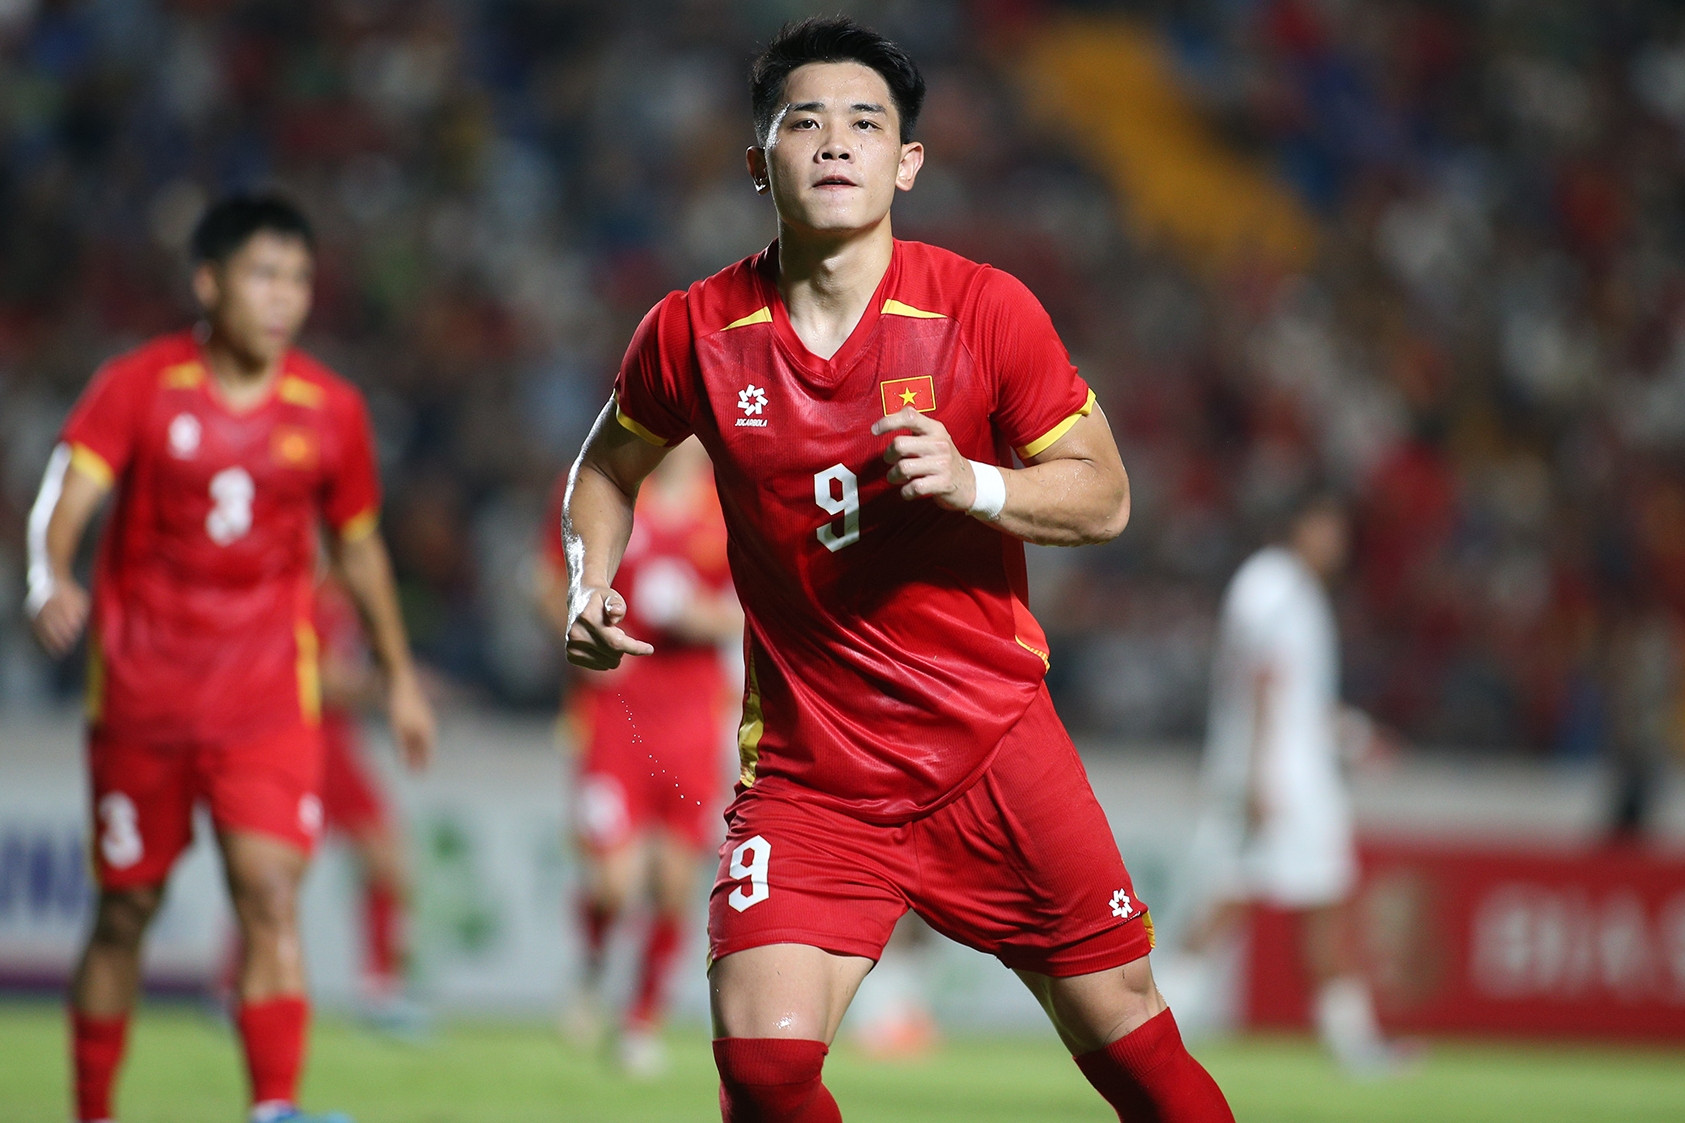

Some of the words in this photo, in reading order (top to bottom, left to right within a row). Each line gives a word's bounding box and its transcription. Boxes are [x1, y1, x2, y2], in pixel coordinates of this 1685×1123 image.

[814, 463, 859, 553] 9
[101, 792, 144, 869] 3
[728, 834, 772, 913] 9
